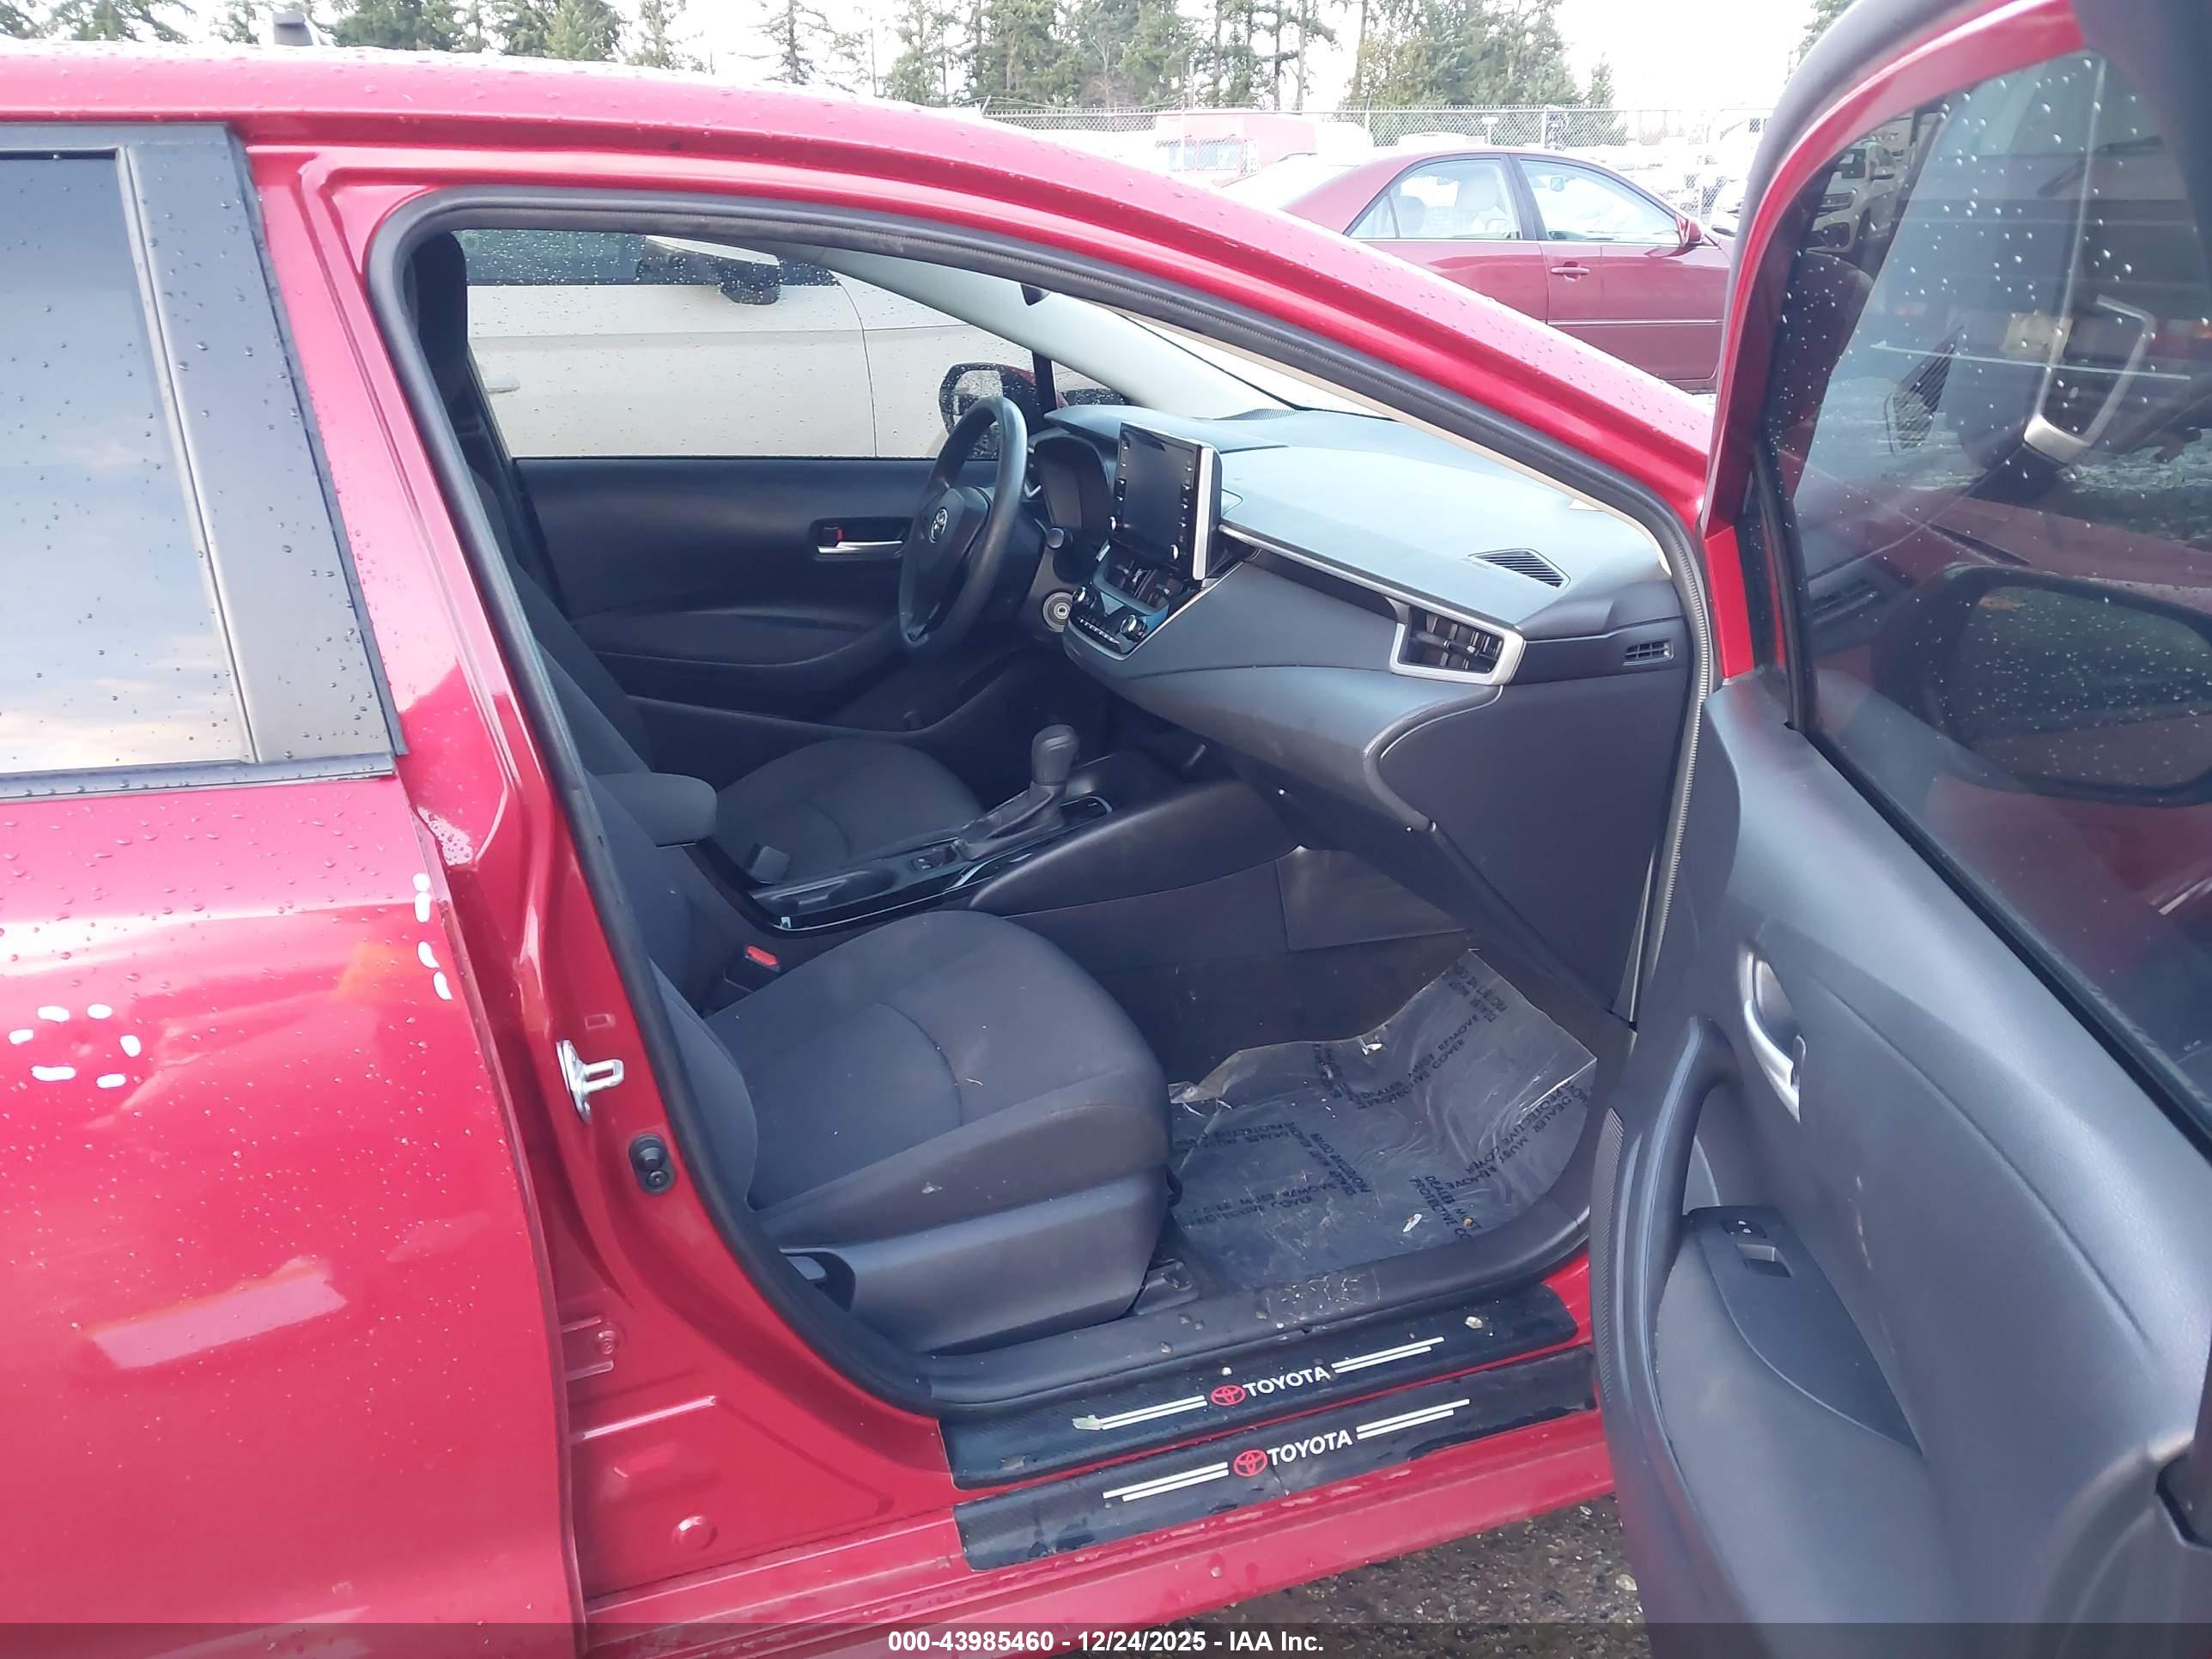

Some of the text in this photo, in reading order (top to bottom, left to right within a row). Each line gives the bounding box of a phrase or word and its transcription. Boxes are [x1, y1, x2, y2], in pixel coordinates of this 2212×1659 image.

[1437, 1014, 1478, 1051] REMOVE
[1432, 1039, 1465, 1069] COVER
[1444, 1095, 1572, 1189] DEALER MUST REMOVE
[1465, 1088, 1564, 1175] PROTECTIVE COVER
[1409, 1178, 1458, 1226] PROTECTIVE
[1424, 1176, 1455, 1204] DEALER
[1242, 1366, 1331, 1397] TOYOTA
[1267, 1429, 1353, 1466] TOYOTA
